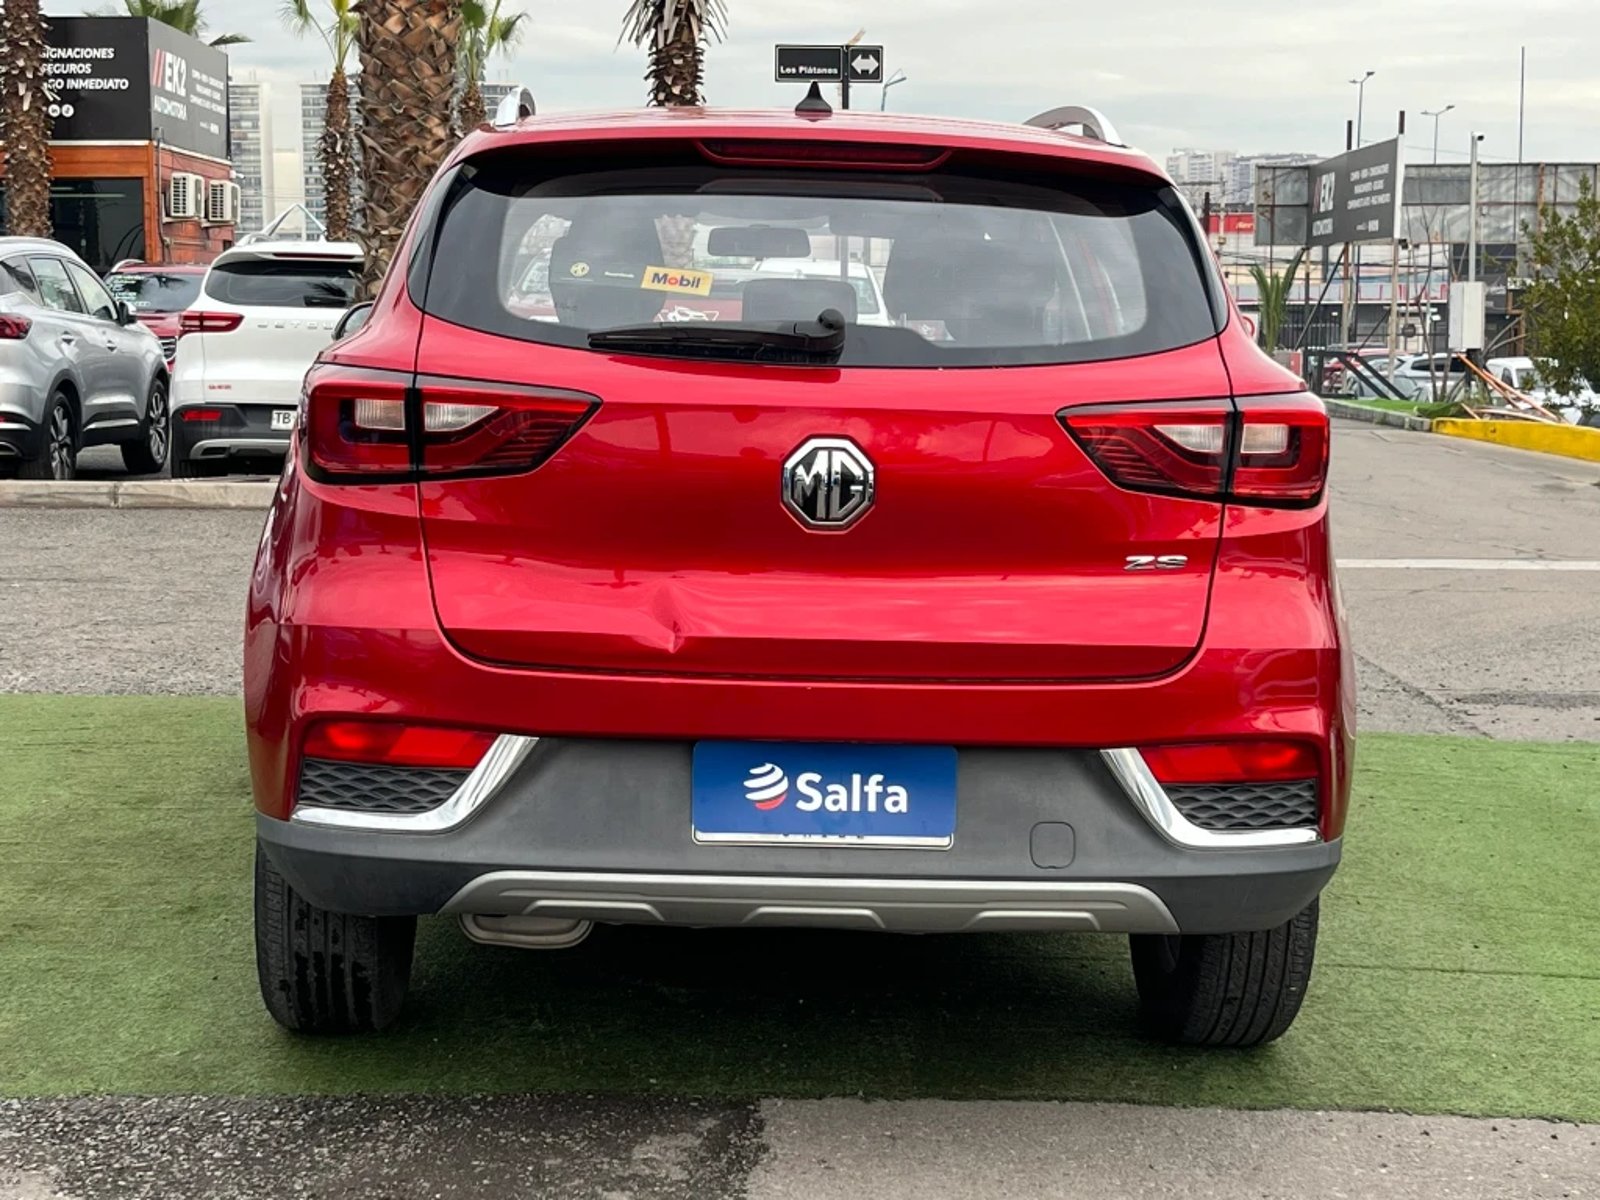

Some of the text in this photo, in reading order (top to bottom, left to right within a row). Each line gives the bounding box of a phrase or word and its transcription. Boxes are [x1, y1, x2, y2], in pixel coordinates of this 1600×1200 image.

[40, 63, 92, 74] SEGUROS
[780, 65, 797, 74] Los
[66, 78, 129, 90] INMEDIATO
[651, 272, 701, 289] Mobil
[793, 450, 864, 520] MG
[1123, 554, 1189, 571] ZS
[795, 772, 908, 814] Salfa
